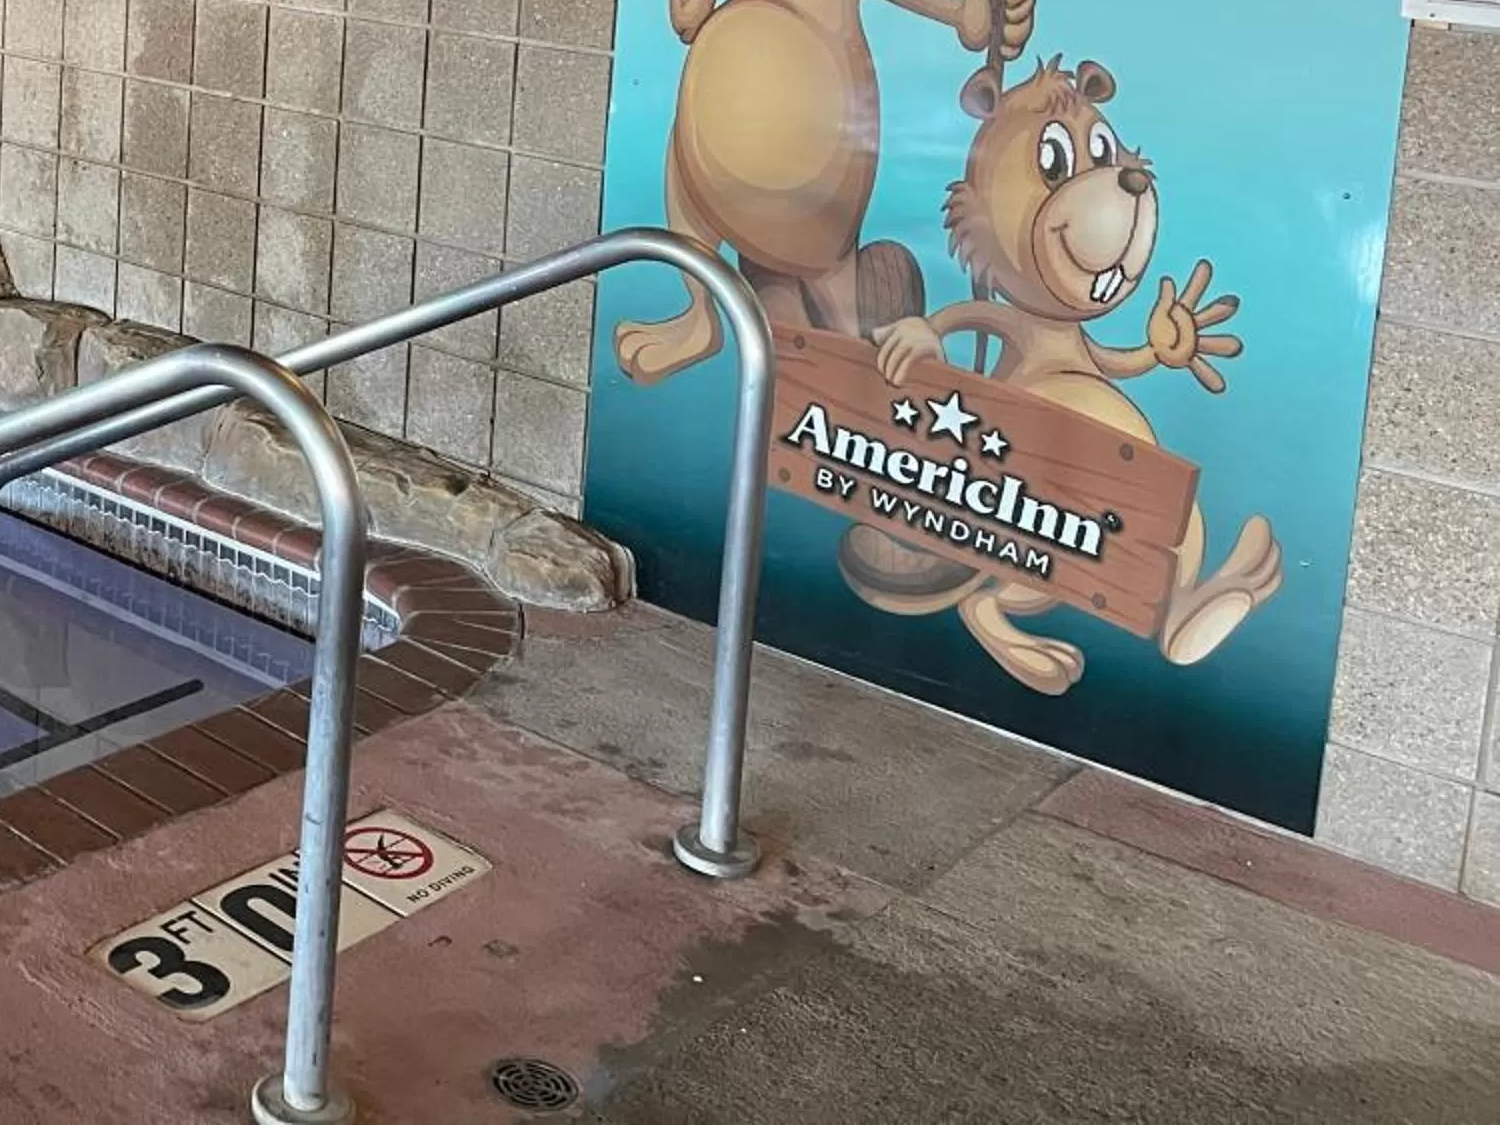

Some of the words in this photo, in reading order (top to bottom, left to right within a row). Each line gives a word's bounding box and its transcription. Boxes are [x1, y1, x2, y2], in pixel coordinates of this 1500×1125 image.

[787, 403, 1101, 556] AmericInn
[816, 467, 855, 496] BY
[871, 487, 1049, 574] WYNDHAM
[406, 889, 430, 904] NO
[428, 865, 476, 892] DIVING
[159, 910, 214, 945] FT
[108, 936, 231, 1010] 3
